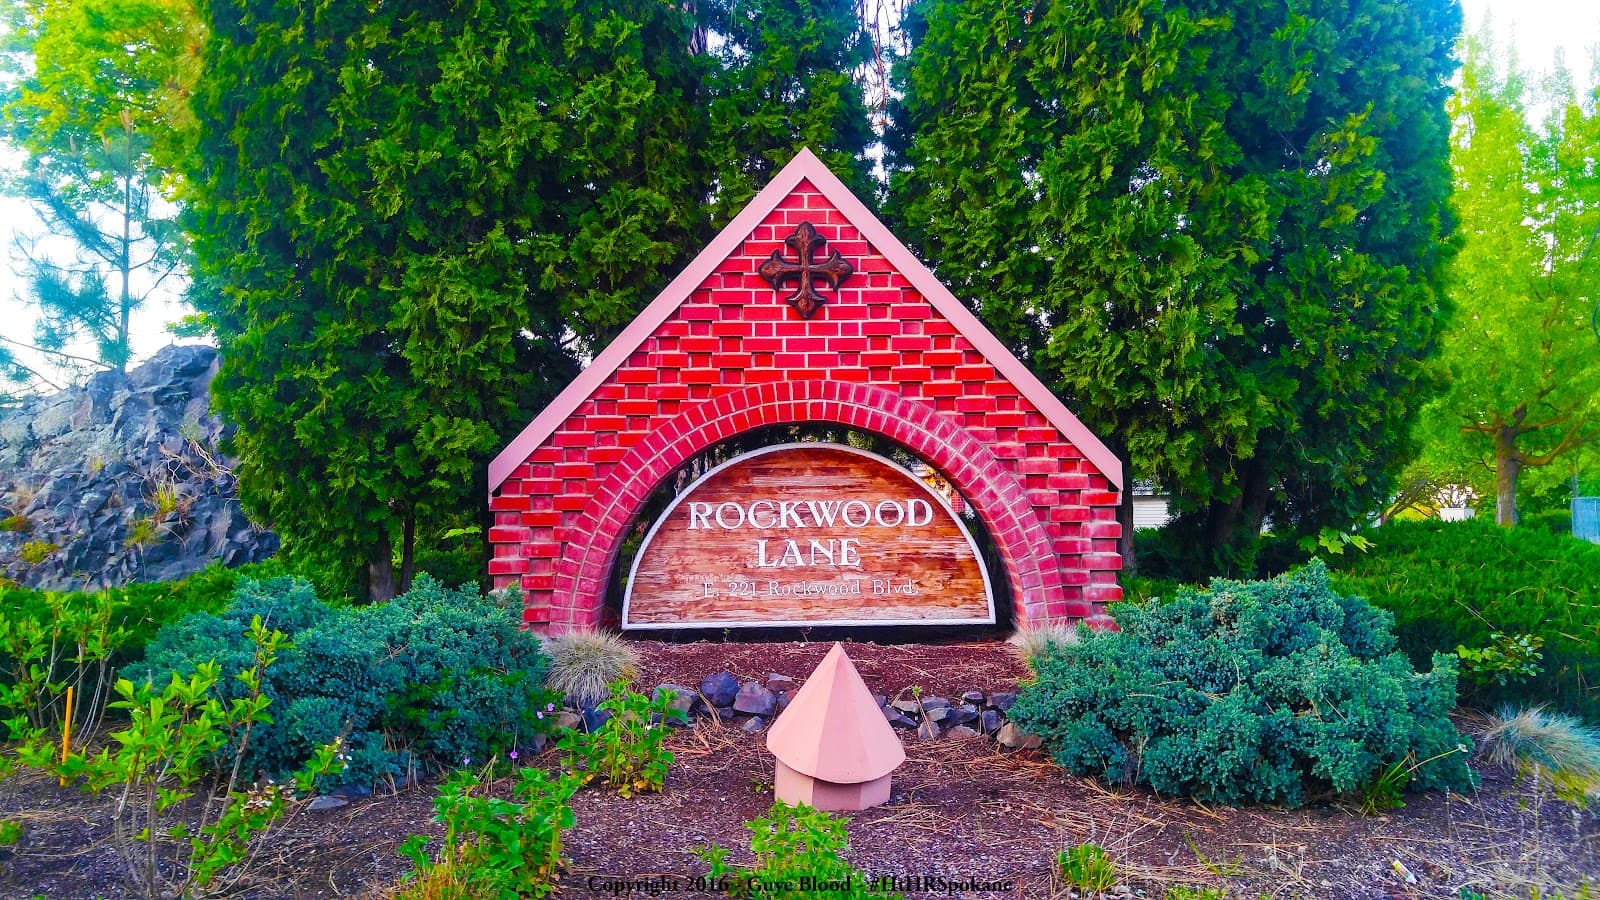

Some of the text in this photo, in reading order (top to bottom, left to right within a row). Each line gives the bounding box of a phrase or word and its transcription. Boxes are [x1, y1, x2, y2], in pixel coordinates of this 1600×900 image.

[687, 498, 934, 530] ROCKWOOD
[756, 537, 862, 568] LANE
[703, 579, 920, 598] E. 221 Rockwood Blvd.
